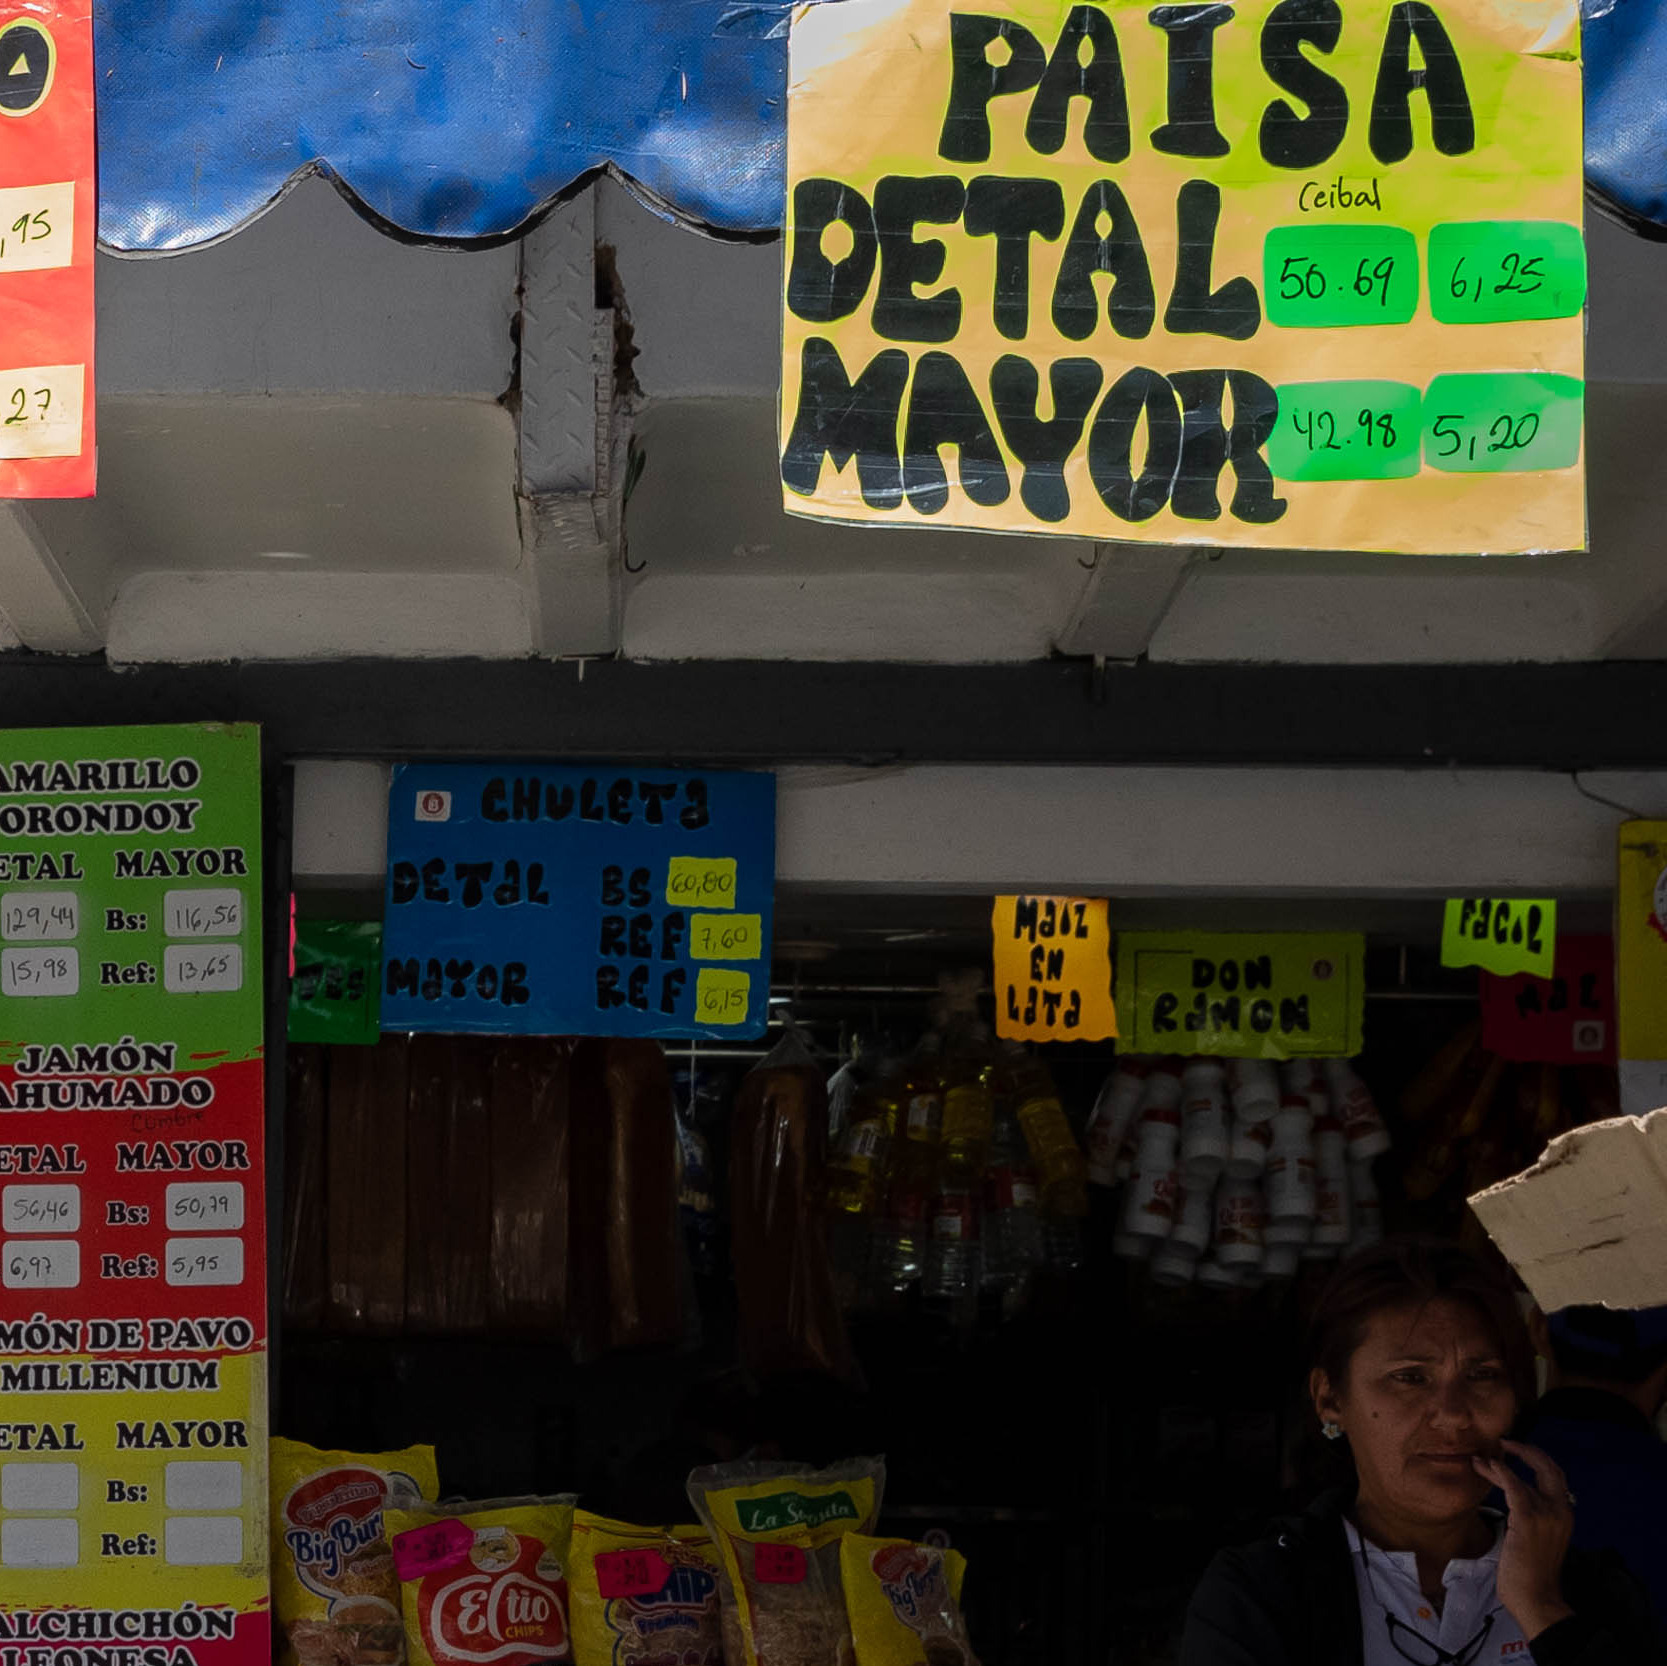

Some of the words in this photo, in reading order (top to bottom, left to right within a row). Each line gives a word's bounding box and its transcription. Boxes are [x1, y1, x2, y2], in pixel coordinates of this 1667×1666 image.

[938, 0, 1474, 169] PAISA
[787, 176, 1262, 342] DETAL
[1279, 255, 1395, 304] 50.69
[1450, 256, 1544, 298] 6,25
[782, 338, 1288, 524] MAYOR
[1293, 406, 1397, 451] 42.98
[1433, 413, 1539, 458] 5,20
[602, 865, 651, 906] BS
[599, 912, 685, 960] REF
[1029, 948, 1064, 981] EN
[1192, 955, 1272, 990] DON
[596, 965, 685, 1014] REF
[15, 1038, 175, 1075] JAMÓN
[87, 1321, 143, 1351] DE
[150, 1319, 253, 1351] PAVO
[0, 1361, 219, 1394] MILLENIUM
[505, 1625, 544, 1638] CHIPS
